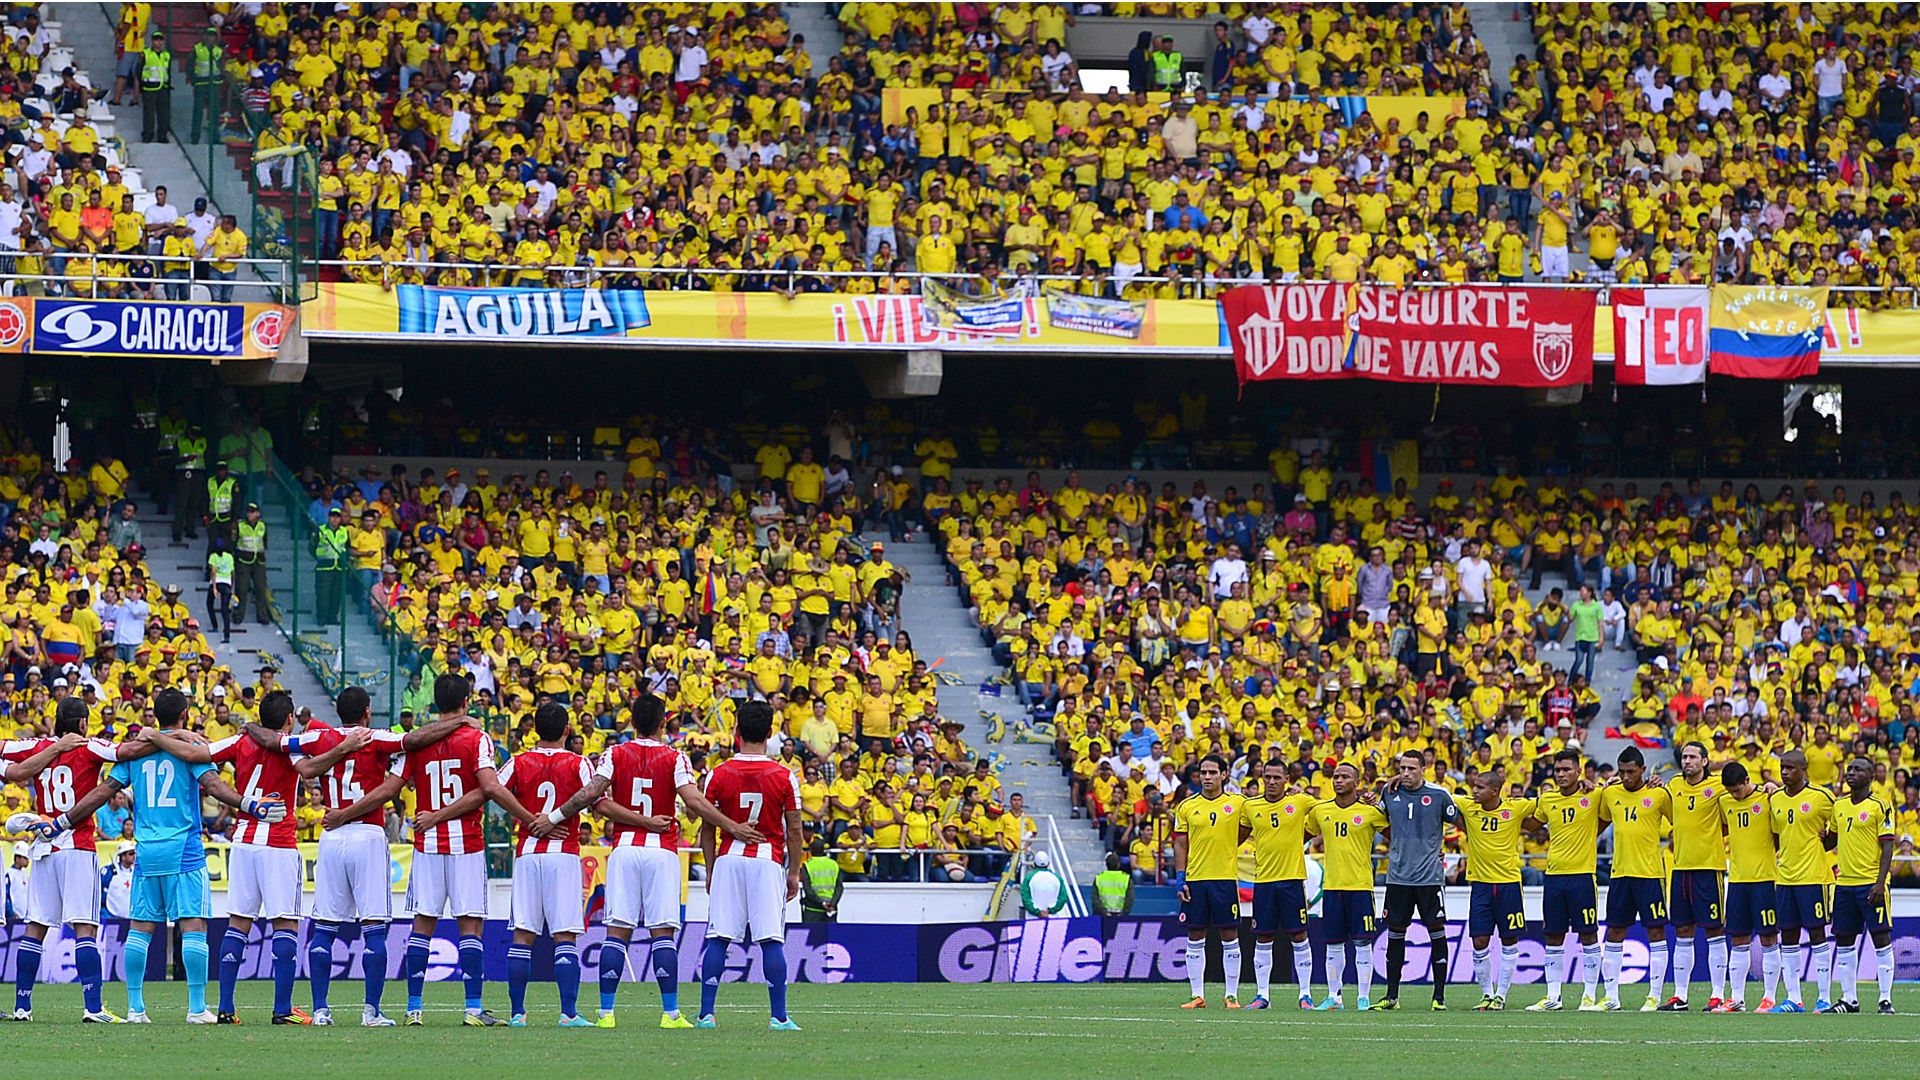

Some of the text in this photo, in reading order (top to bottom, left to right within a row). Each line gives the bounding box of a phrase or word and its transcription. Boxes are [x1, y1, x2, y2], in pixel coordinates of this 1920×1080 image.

[435, 289, 614, 336] AGUILA
[1263, 285, 1328, 322] VOY
[1358, 286, 1531, 330] SEGUIRTE
[120, 306, 234, 352] CARACOL
[1617, 304, 1703, 366] TEO
[1286, 335, 1500, 380] DONDE VAYAS
[39, 765, 75, 813] 18
[142, 759, 177, 808] 12
[244, 763, 263, 798] 4
[327, 759, 365, 809] 14
[425, 758, 464, 811] 15
[537, 780, 556, 815] 2
[630, 777, 653, 817] 5
[1687, 795, 1696, 811] 3
[740, 792, 763, 823] 7
[1407, 802, 1414, 820] 1
[1561, 807, 1576, 824] 19
[1624, 806, 1638, 823] 14
[1787, 808, 1794, 825] 8
[1209, 811, 1217, 827] 9
[1270, 812, 1279, 828] 5
[1480, 816, 1498, 832] 20
[1737, 811, 1749, 828] 10
[1846, 817, 1854, 833] 7
[1334, 821, 1348, 838] 18
[1231, 903, 1239, 920] 9
[1300, 908, 1307, 925] 5
[1581, 908, 1596, 926] 19
[1649, 902, 1666, 920] 14
[1709, 902, 1718, 920] 3
[1760, 909, 1777, 927] 10
[1814, 902, 1823, 919] 8
[1876, 906, 1884, 924] 7
[1507, 911, 1524, 930] 20
[938, 917, 1190, 984] Gillette
